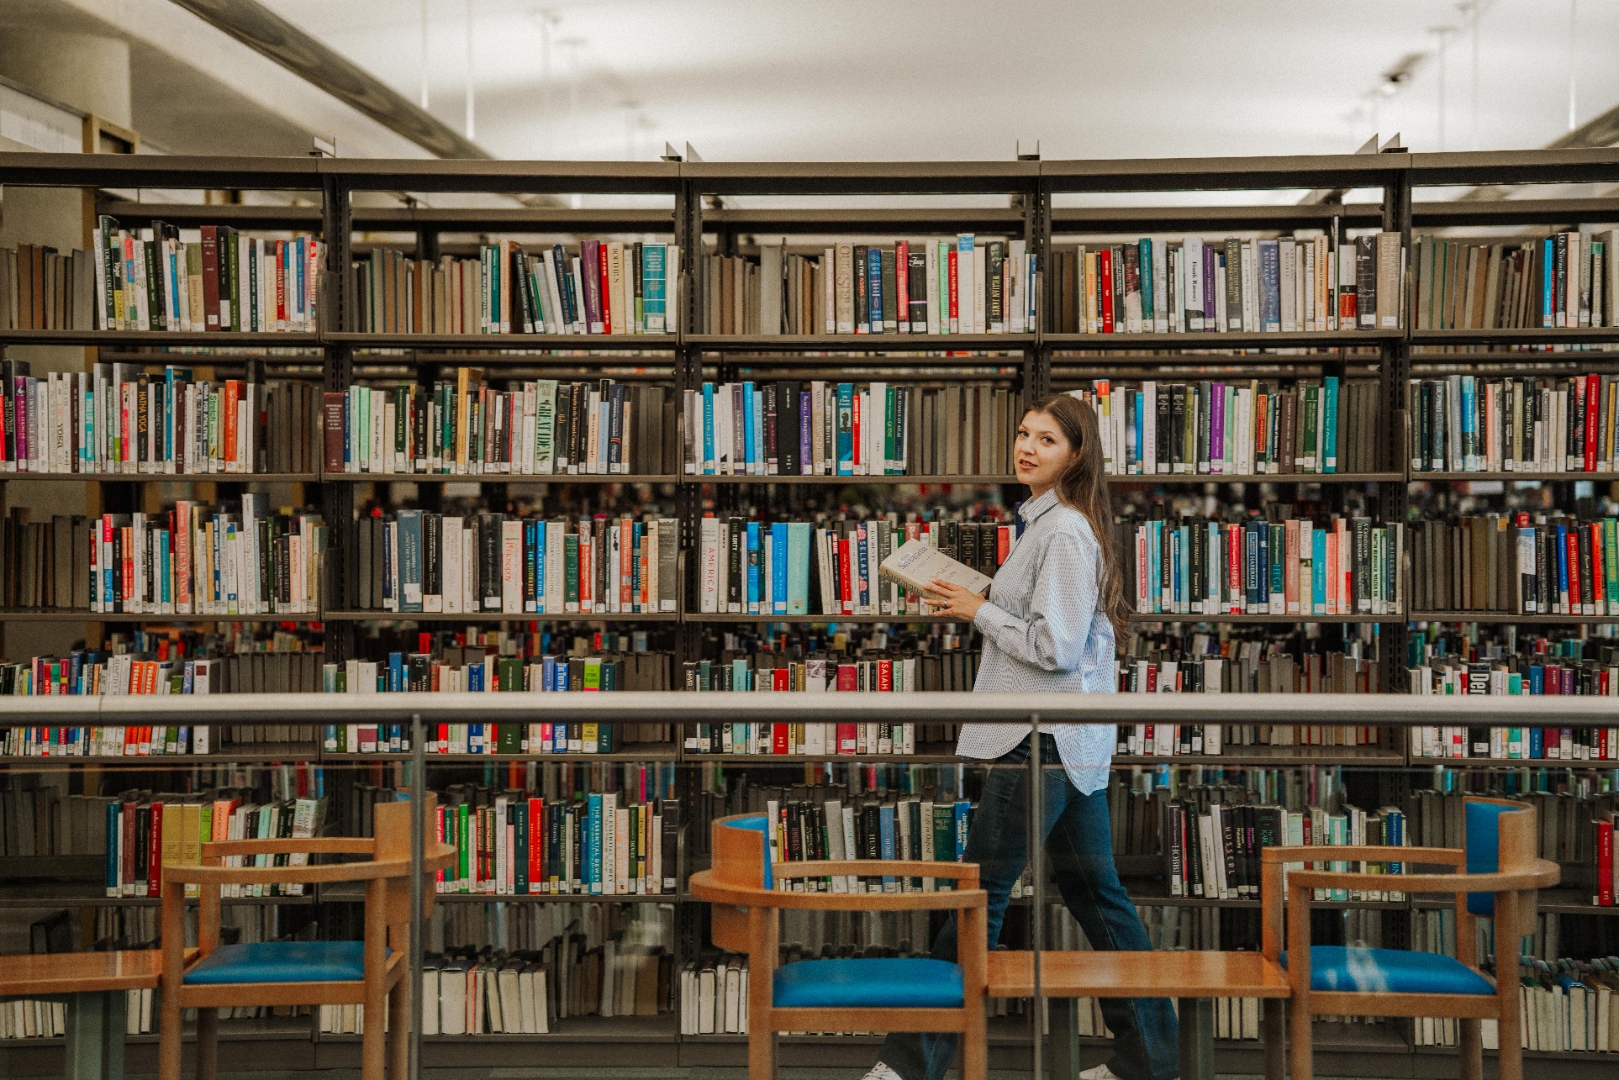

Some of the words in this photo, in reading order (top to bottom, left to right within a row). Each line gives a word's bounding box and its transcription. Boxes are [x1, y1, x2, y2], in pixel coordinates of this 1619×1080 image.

[1559, 235, 1566, 246] On
[113, 262, 121, 278] Yoga
[1558, 248, 1566, 279] Nietzsche
[991, 299, 1001, 317] JAMES
[138, 391, 147, 414] HATHA
[537, 402, 552, 429] GREAT
[138, 415, 147, 433] YOGA
[536, 433, 551, 462] IDEAS
[179, 532, 187, 572] AMERICAN
[505, 542, 514, 583] Philosophy
[860, 541, 868, 580] SELLARS
[179, 574, 188, 597] YOGA
[1249, 556, 1257, 588] HABERMAS
[1273, 563, 1281, 593] HEGEL
[183, 666, 192, 689] YOGA
[881, 660, 889, 690] ISAIAH
[869, 834, 878, 857] HUME
[1171, 845, 1181, 875] HOBBE
[1224, 827, 1235, 875] HUSSERL
